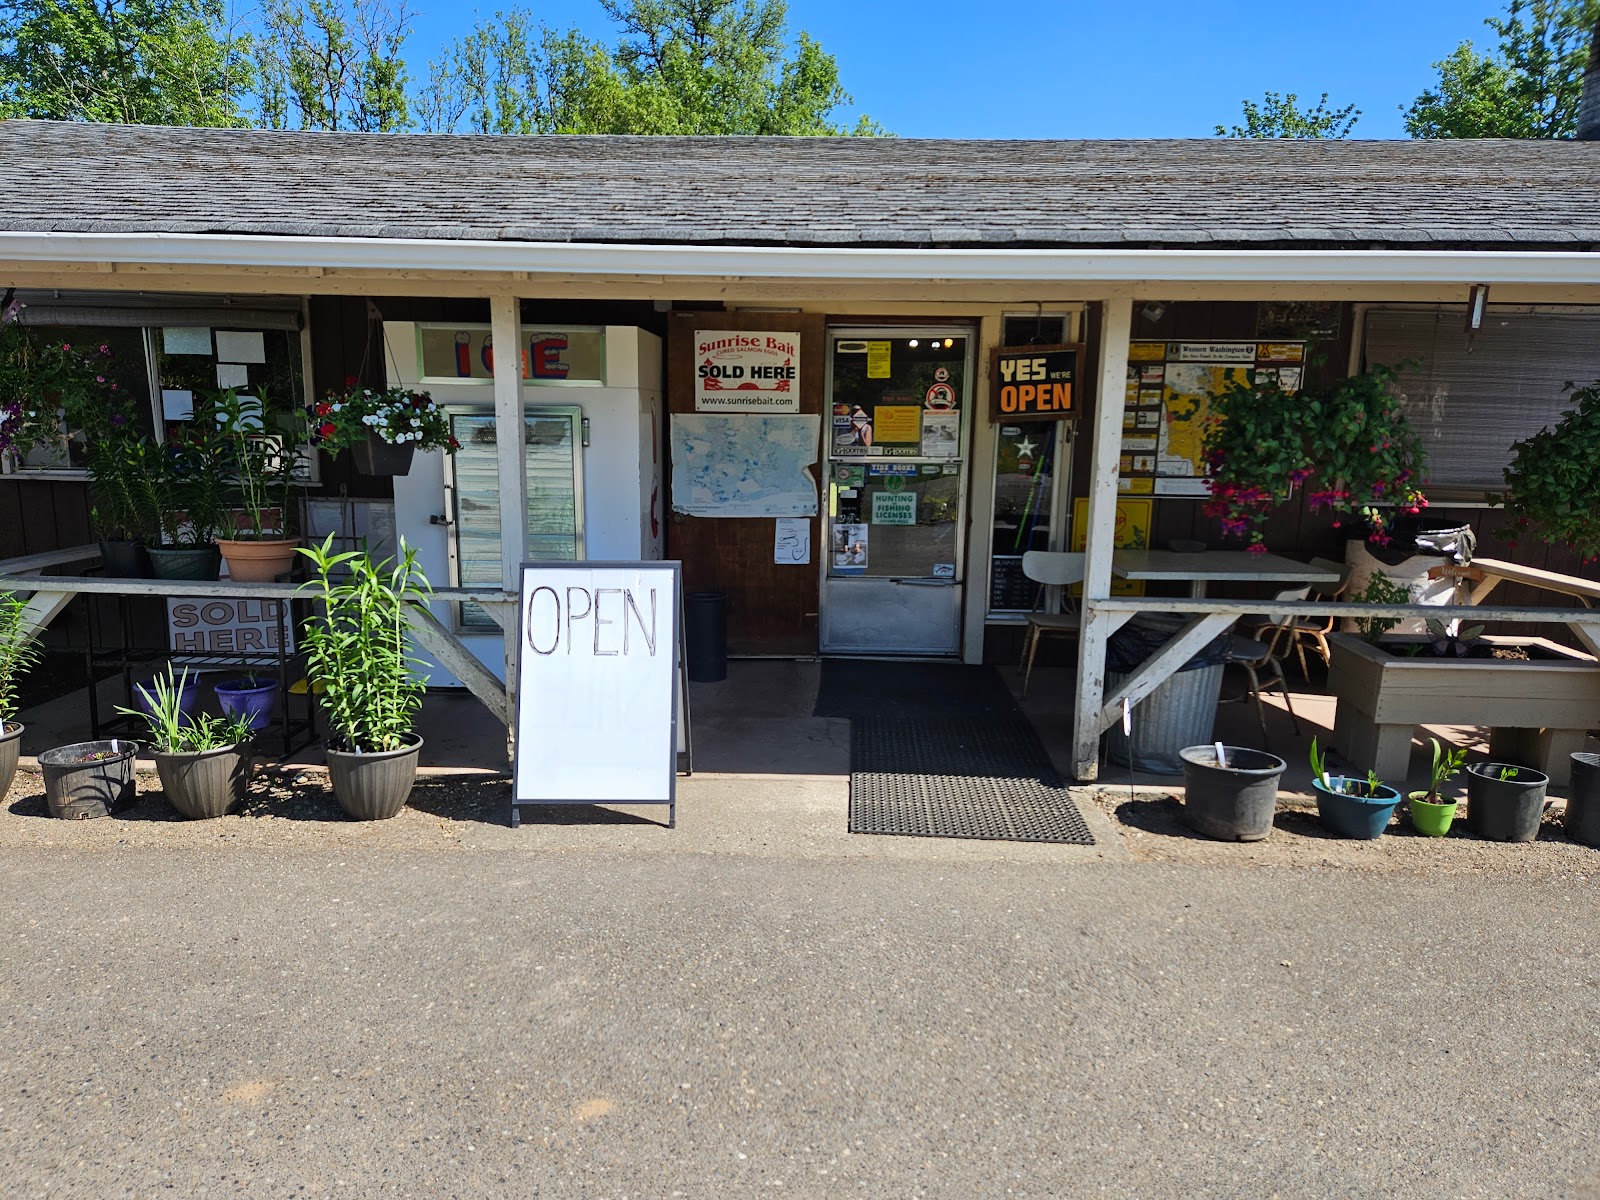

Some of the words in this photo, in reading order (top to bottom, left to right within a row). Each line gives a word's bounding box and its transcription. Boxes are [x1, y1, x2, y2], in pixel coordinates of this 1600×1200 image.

[699, 334, 761, 356] Sunrise
[766, 336, 795, 357] Bait
[716, 347, 735, 355] CURED
[763, 348, 778, 356] EGGS
[1209, 345, 1245, 354] Washington
[698, 365, 744, 379] SOLD
[750, 366, 796, 379] HERE
[1000, 358, 1047, 382] YES
[1050, 371, 1072, 379] WE'RE
[701, 396, 793, 405] www.sunrisebait.com
[1000, 383, 1072, 412] OPEN
[172, 600, 289, 628] SOLD
[527, 586, 657, 656] OPEN
[174, 626, 291, 653] HERE
